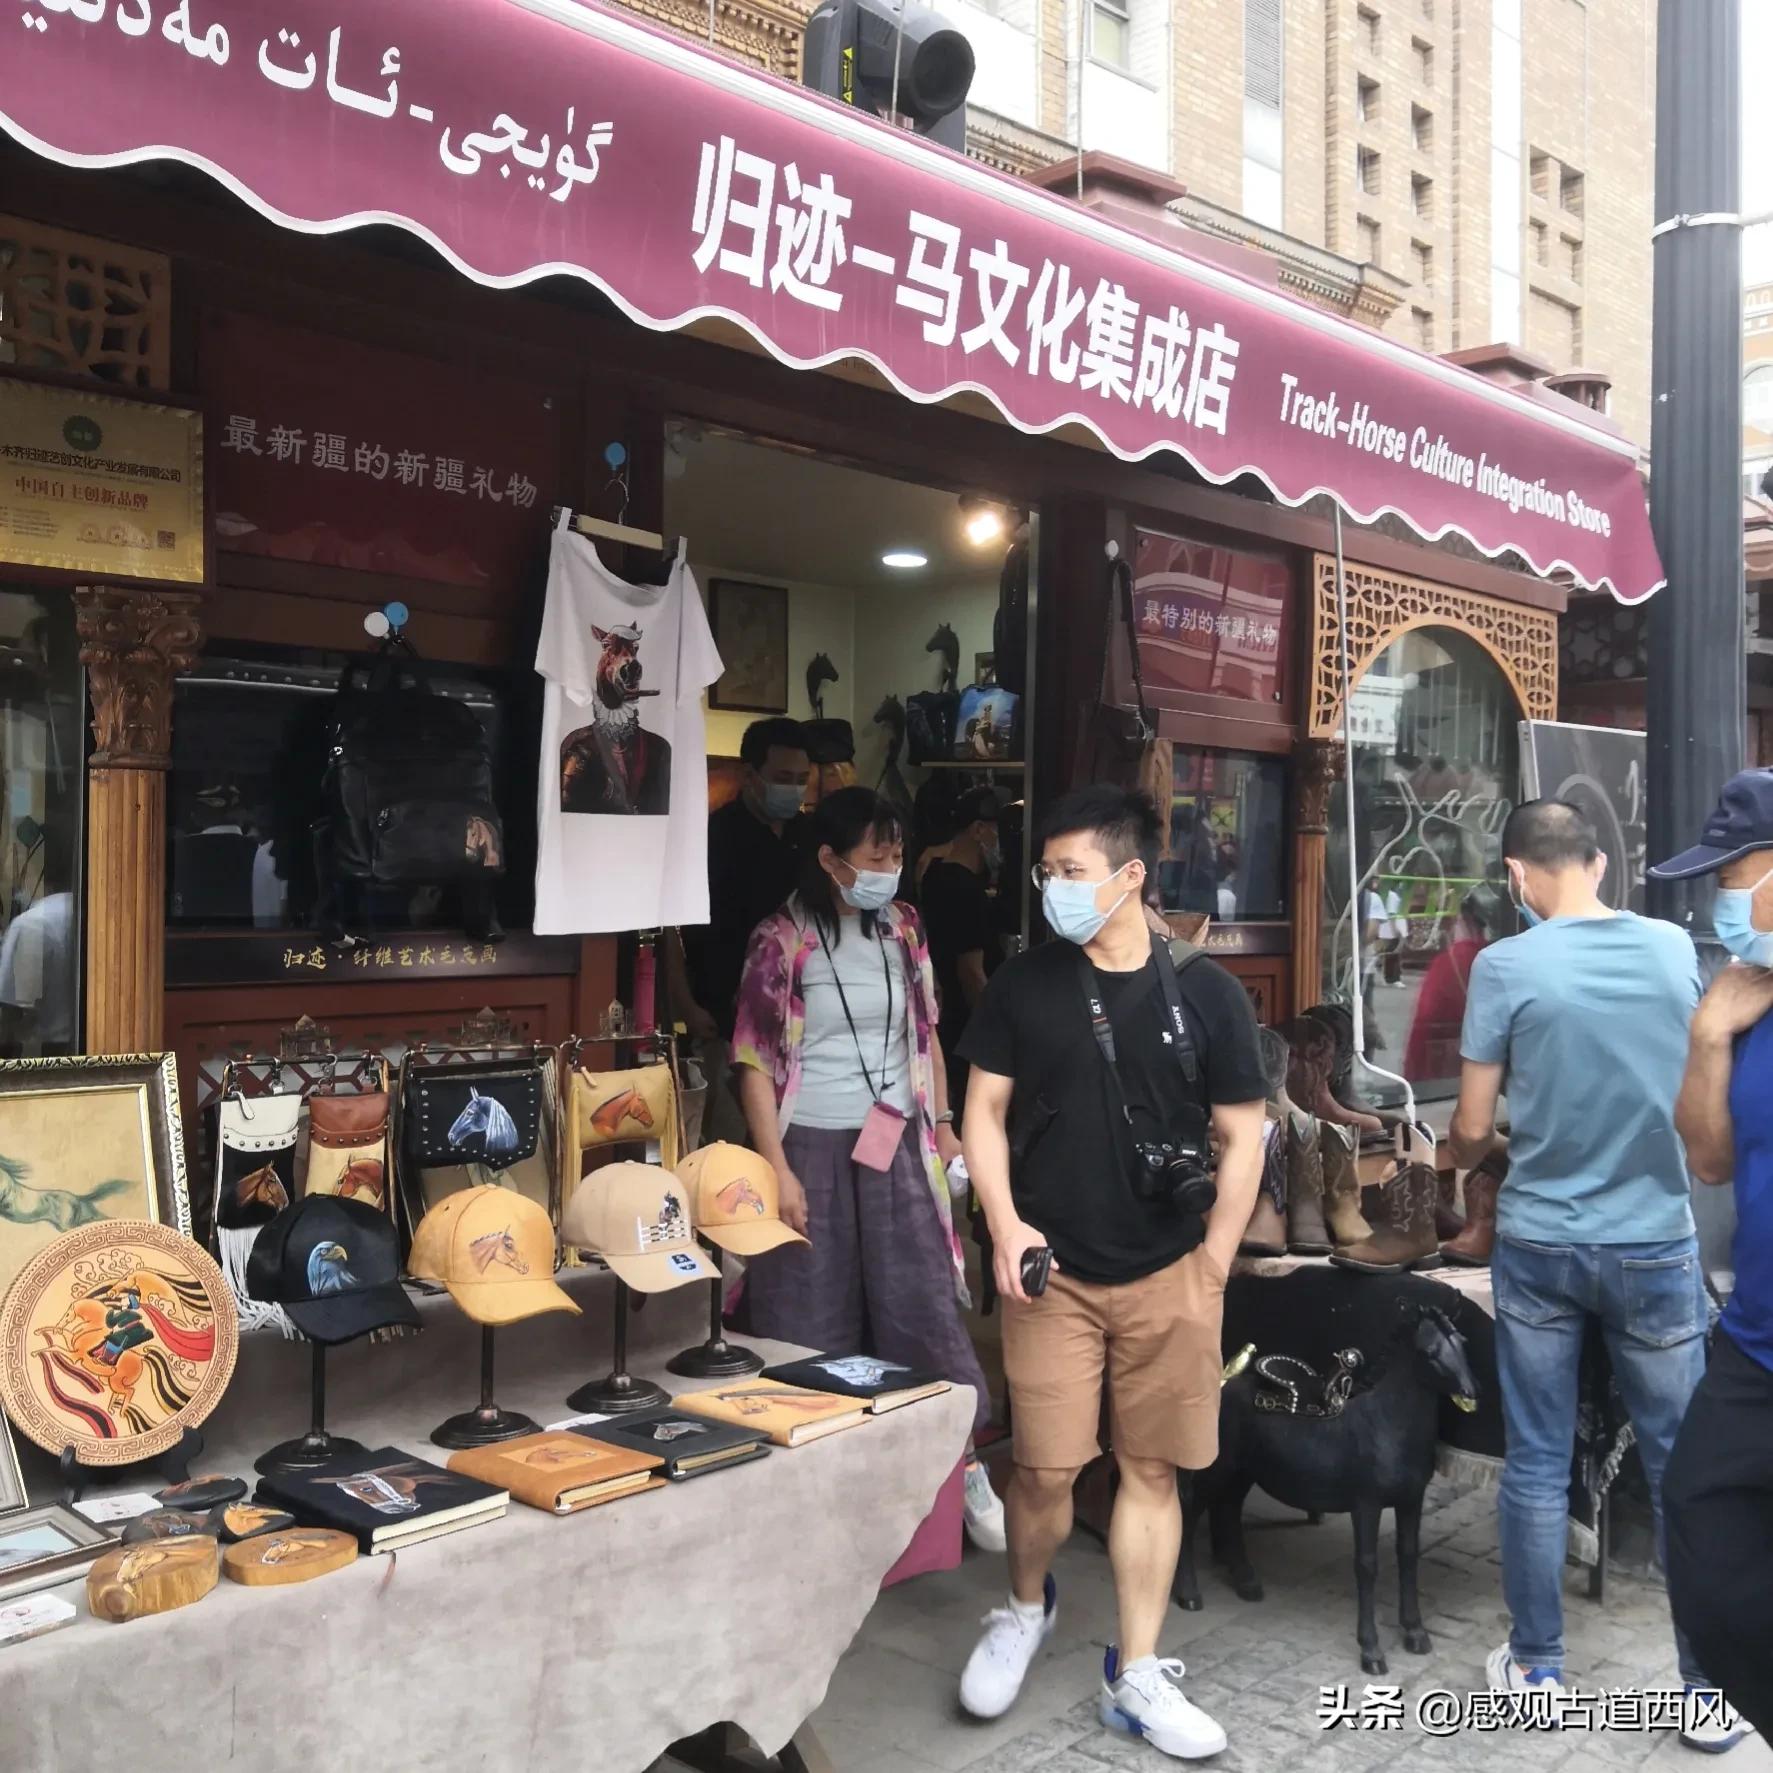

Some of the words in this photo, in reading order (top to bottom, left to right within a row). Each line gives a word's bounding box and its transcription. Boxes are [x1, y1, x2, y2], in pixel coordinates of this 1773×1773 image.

[221, 415, 537, 508] 最新疆的新疆礼物
[1280, 373, 1406, 462] Track-Horse
[1410, 427, 1474, 488] Culture
[1476, 453, 1566, 521] Integration
[1567, 491, 1611, 538] Store
[1142, 600, 1278, 646] 最特别的新疆礼物
[1172, 1005, 1185, 1034] SONY
